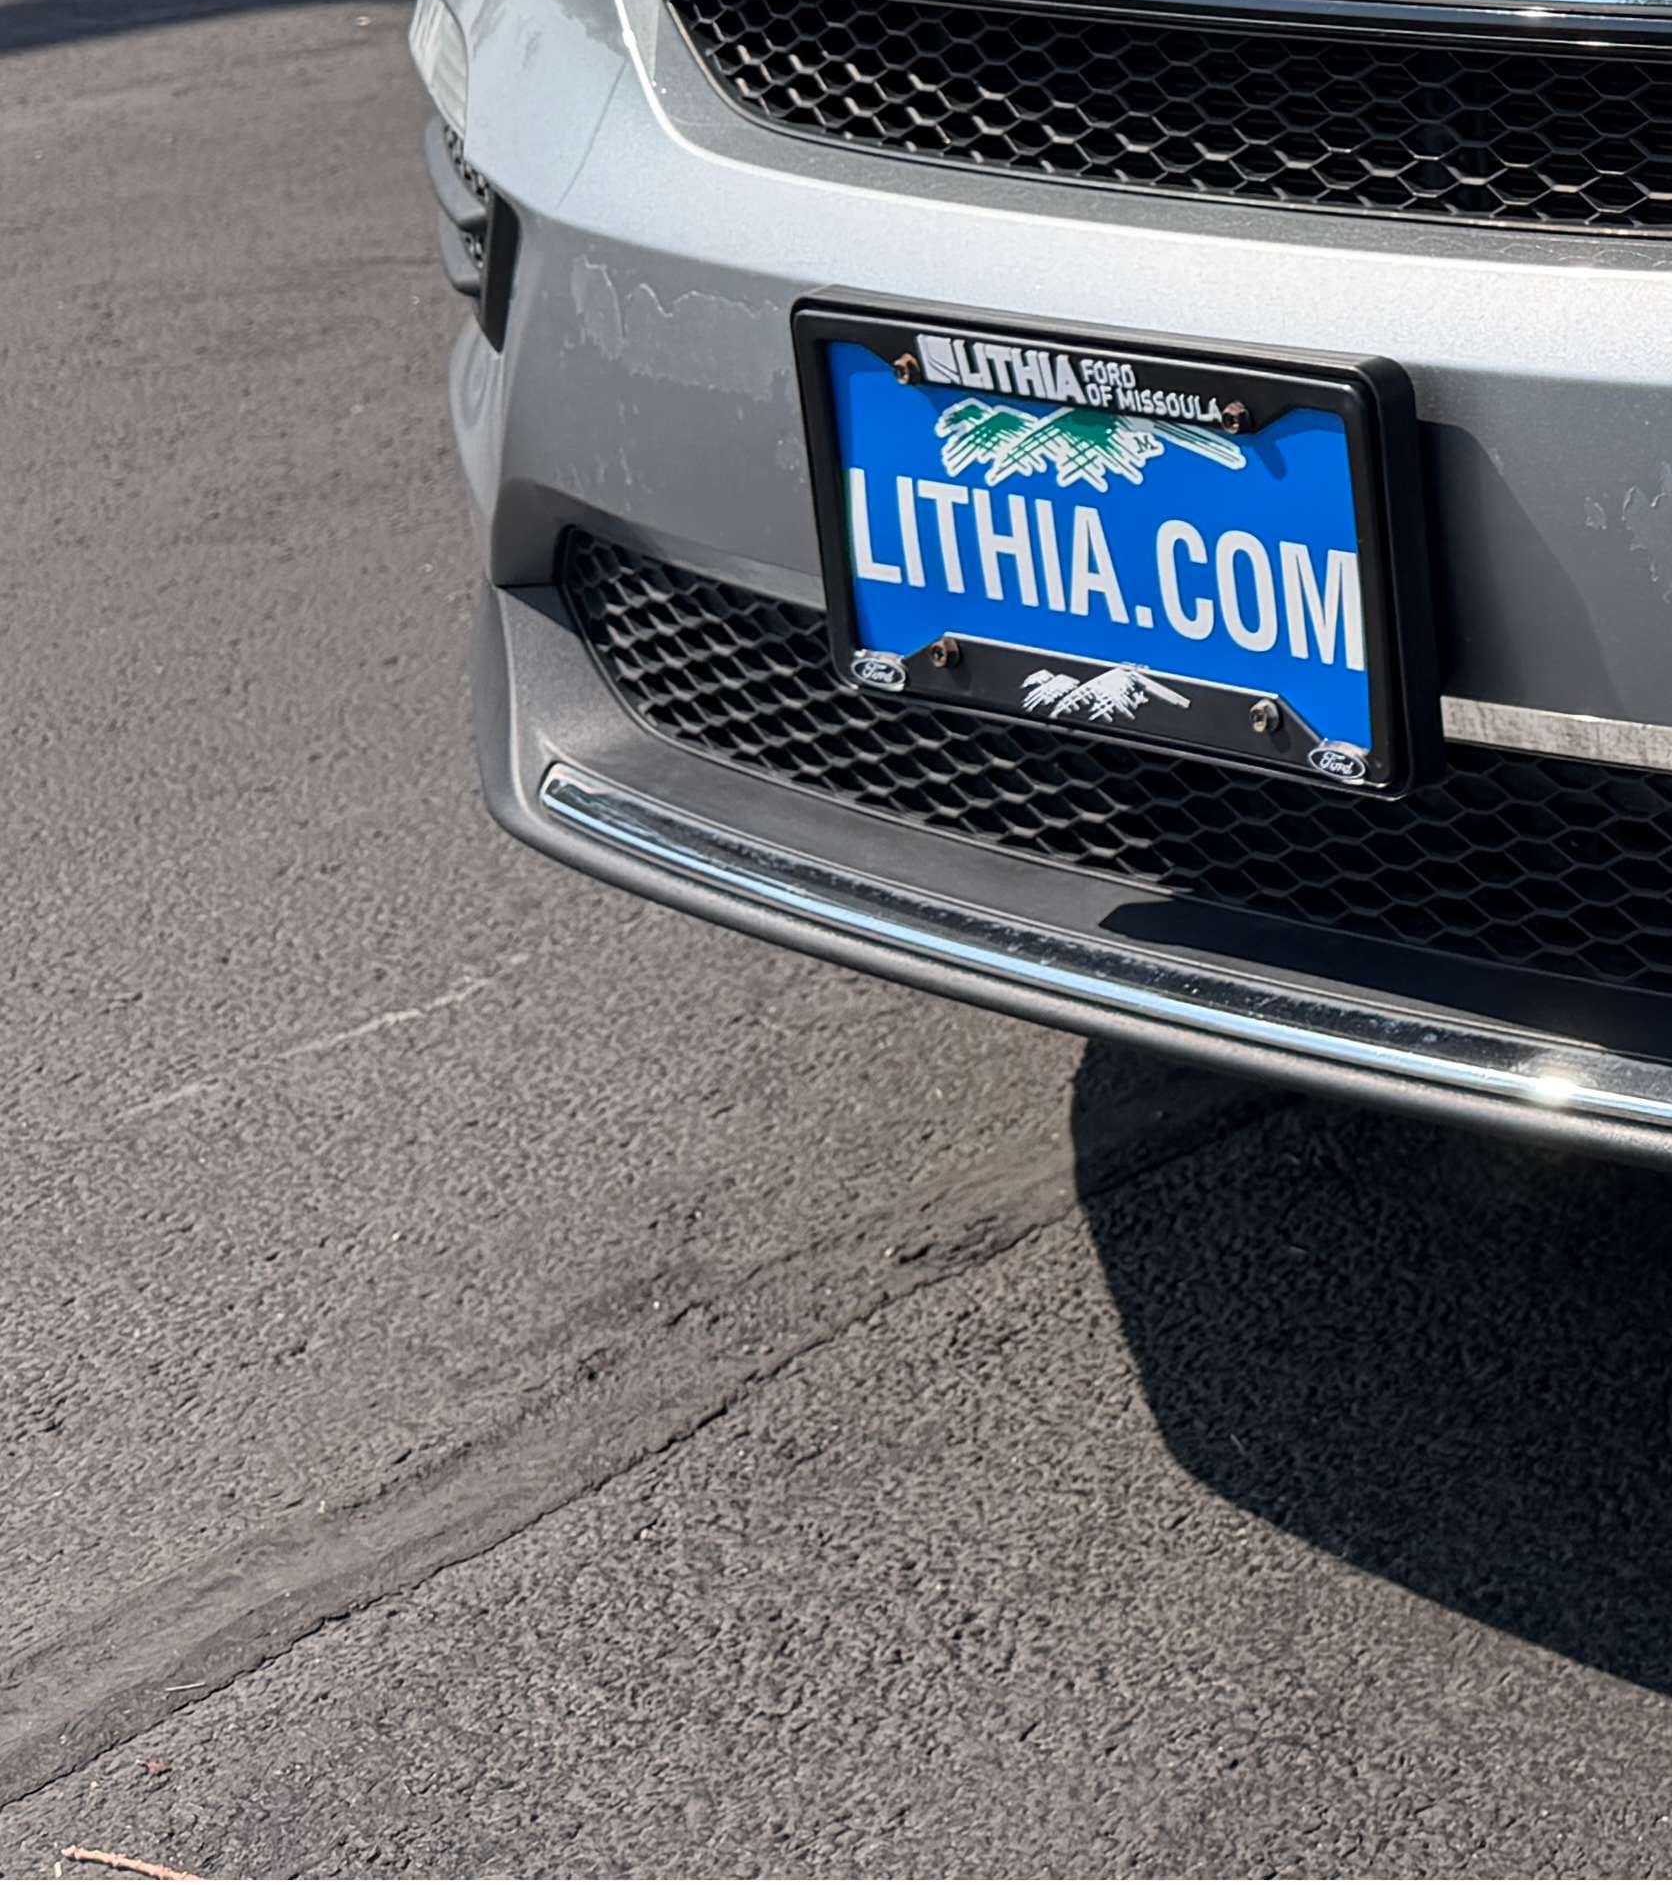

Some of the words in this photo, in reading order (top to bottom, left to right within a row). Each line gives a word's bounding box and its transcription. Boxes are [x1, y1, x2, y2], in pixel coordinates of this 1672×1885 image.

[954, 339, 1086, 404] LITHIA
[1081, 360, 1136, 386] FORD
[1086, 384, 1113, 407] OF
[1118, 389, 1223, 422] MISSOULA
[850, 468, 1365, 671] LITHIA.COM
[1320, 751, 1354, 775] Ford
